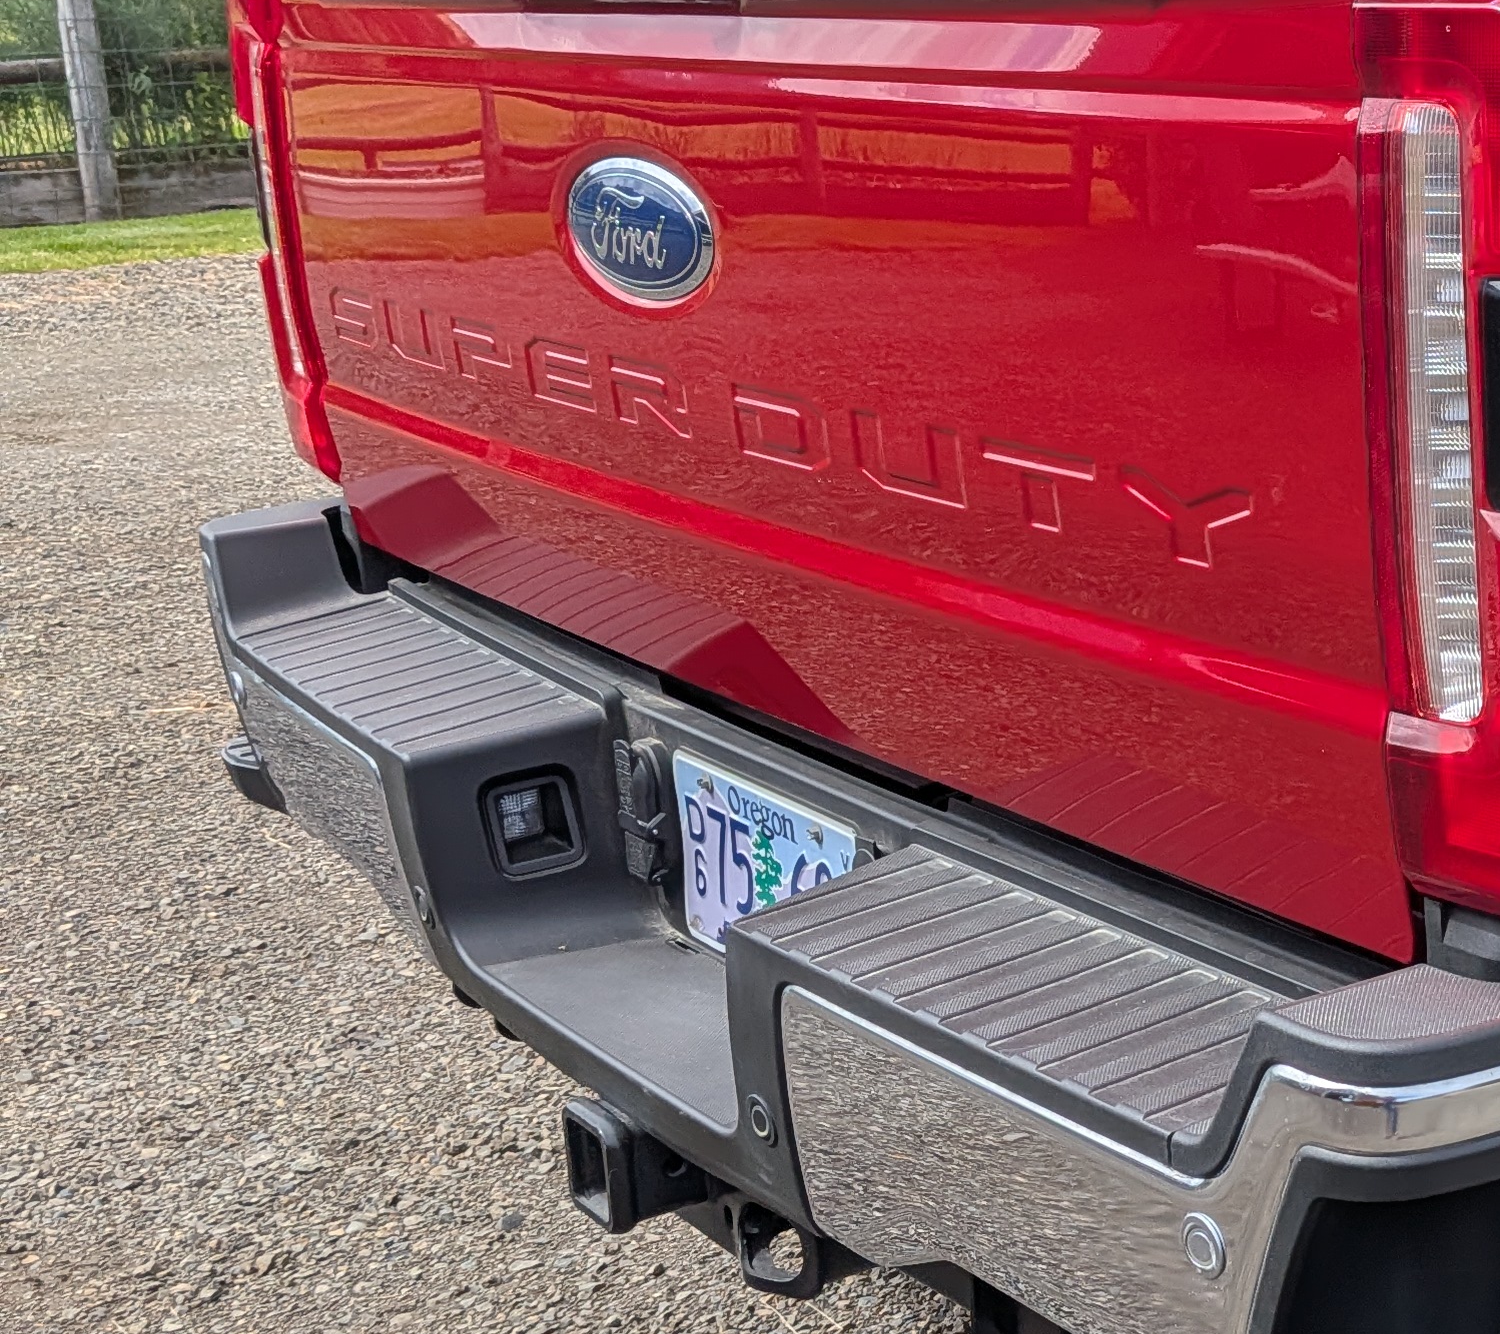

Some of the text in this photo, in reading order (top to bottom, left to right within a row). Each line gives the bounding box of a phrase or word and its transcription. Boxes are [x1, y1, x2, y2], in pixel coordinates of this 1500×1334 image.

[591, 186, 667, 270] Ford
[329, 286, 1254, 568] SUPER DUTY
[727, 785, 799, 845] Oregon
